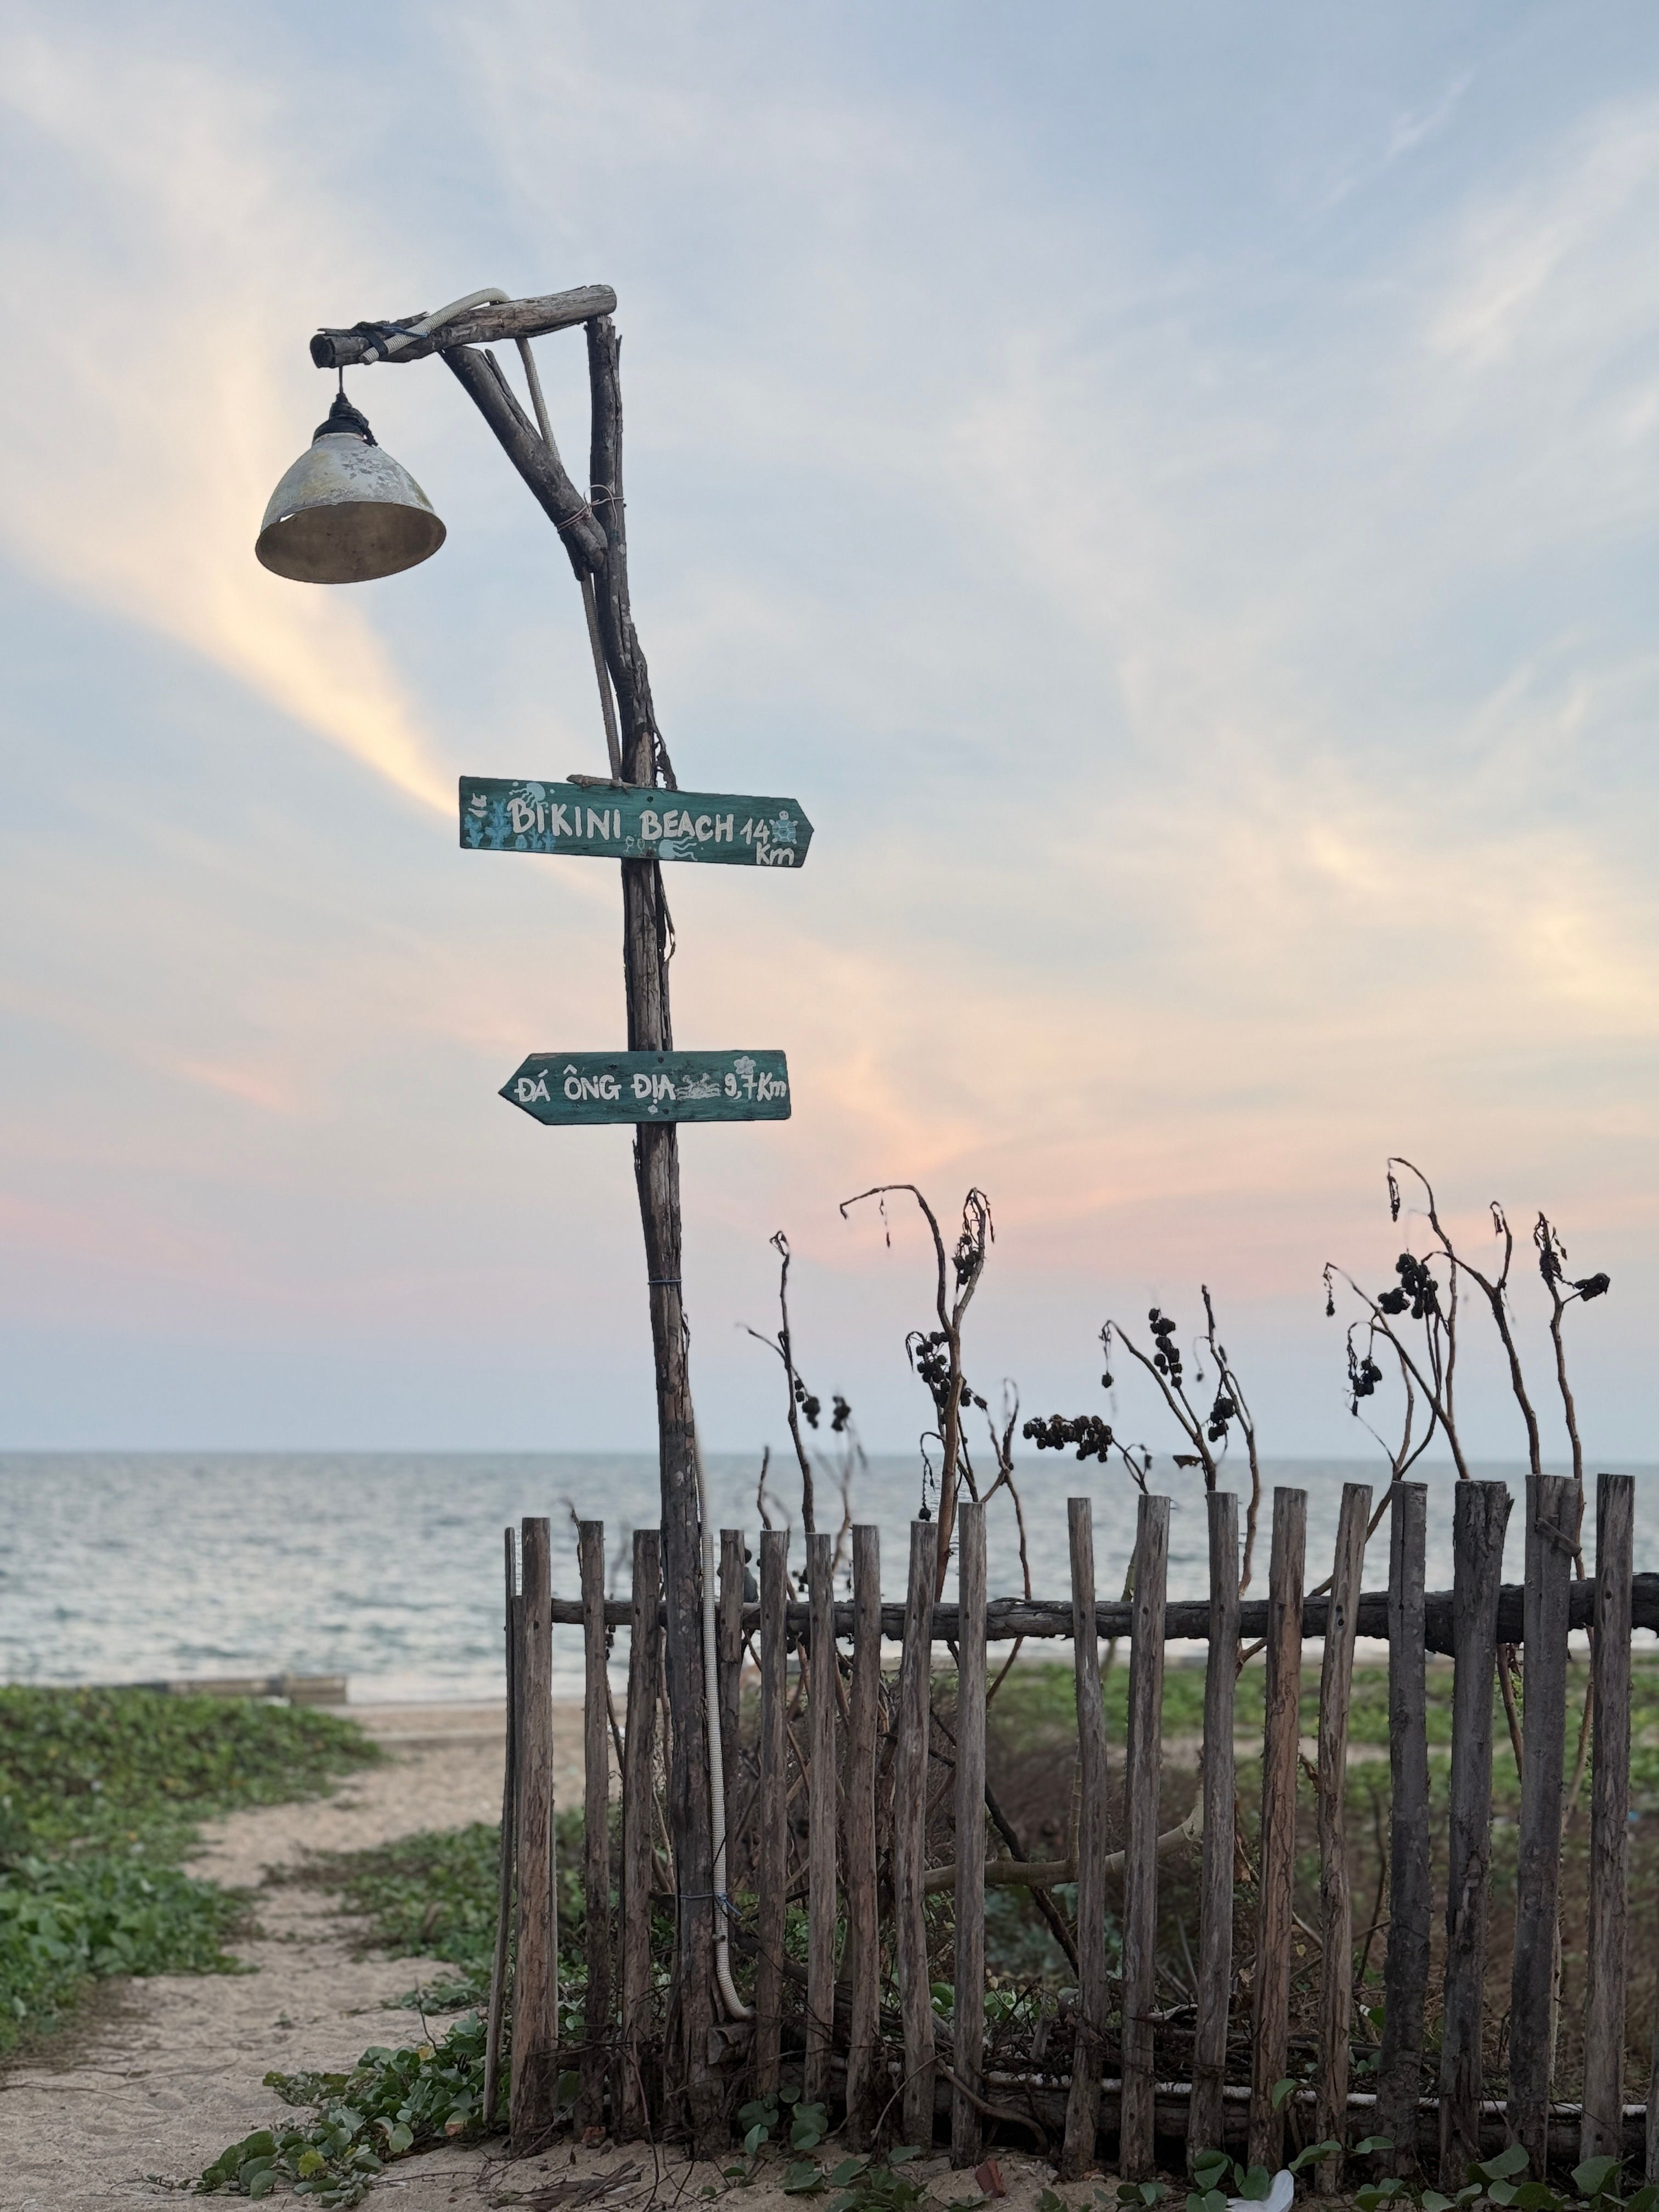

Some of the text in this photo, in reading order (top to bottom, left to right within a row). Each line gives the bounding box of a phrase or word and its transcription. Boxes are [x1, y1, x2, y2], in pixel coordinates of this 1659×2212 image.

[507, 798, 770, 845] BIKINI BEACH 14
[756, 841, 795, 865] Km
[514, 1069, 551, 1102] ĐÁ
[563, 1064, 622, 1101] ÔNG
[630, 1073, 676, 1104] ĐỊA
